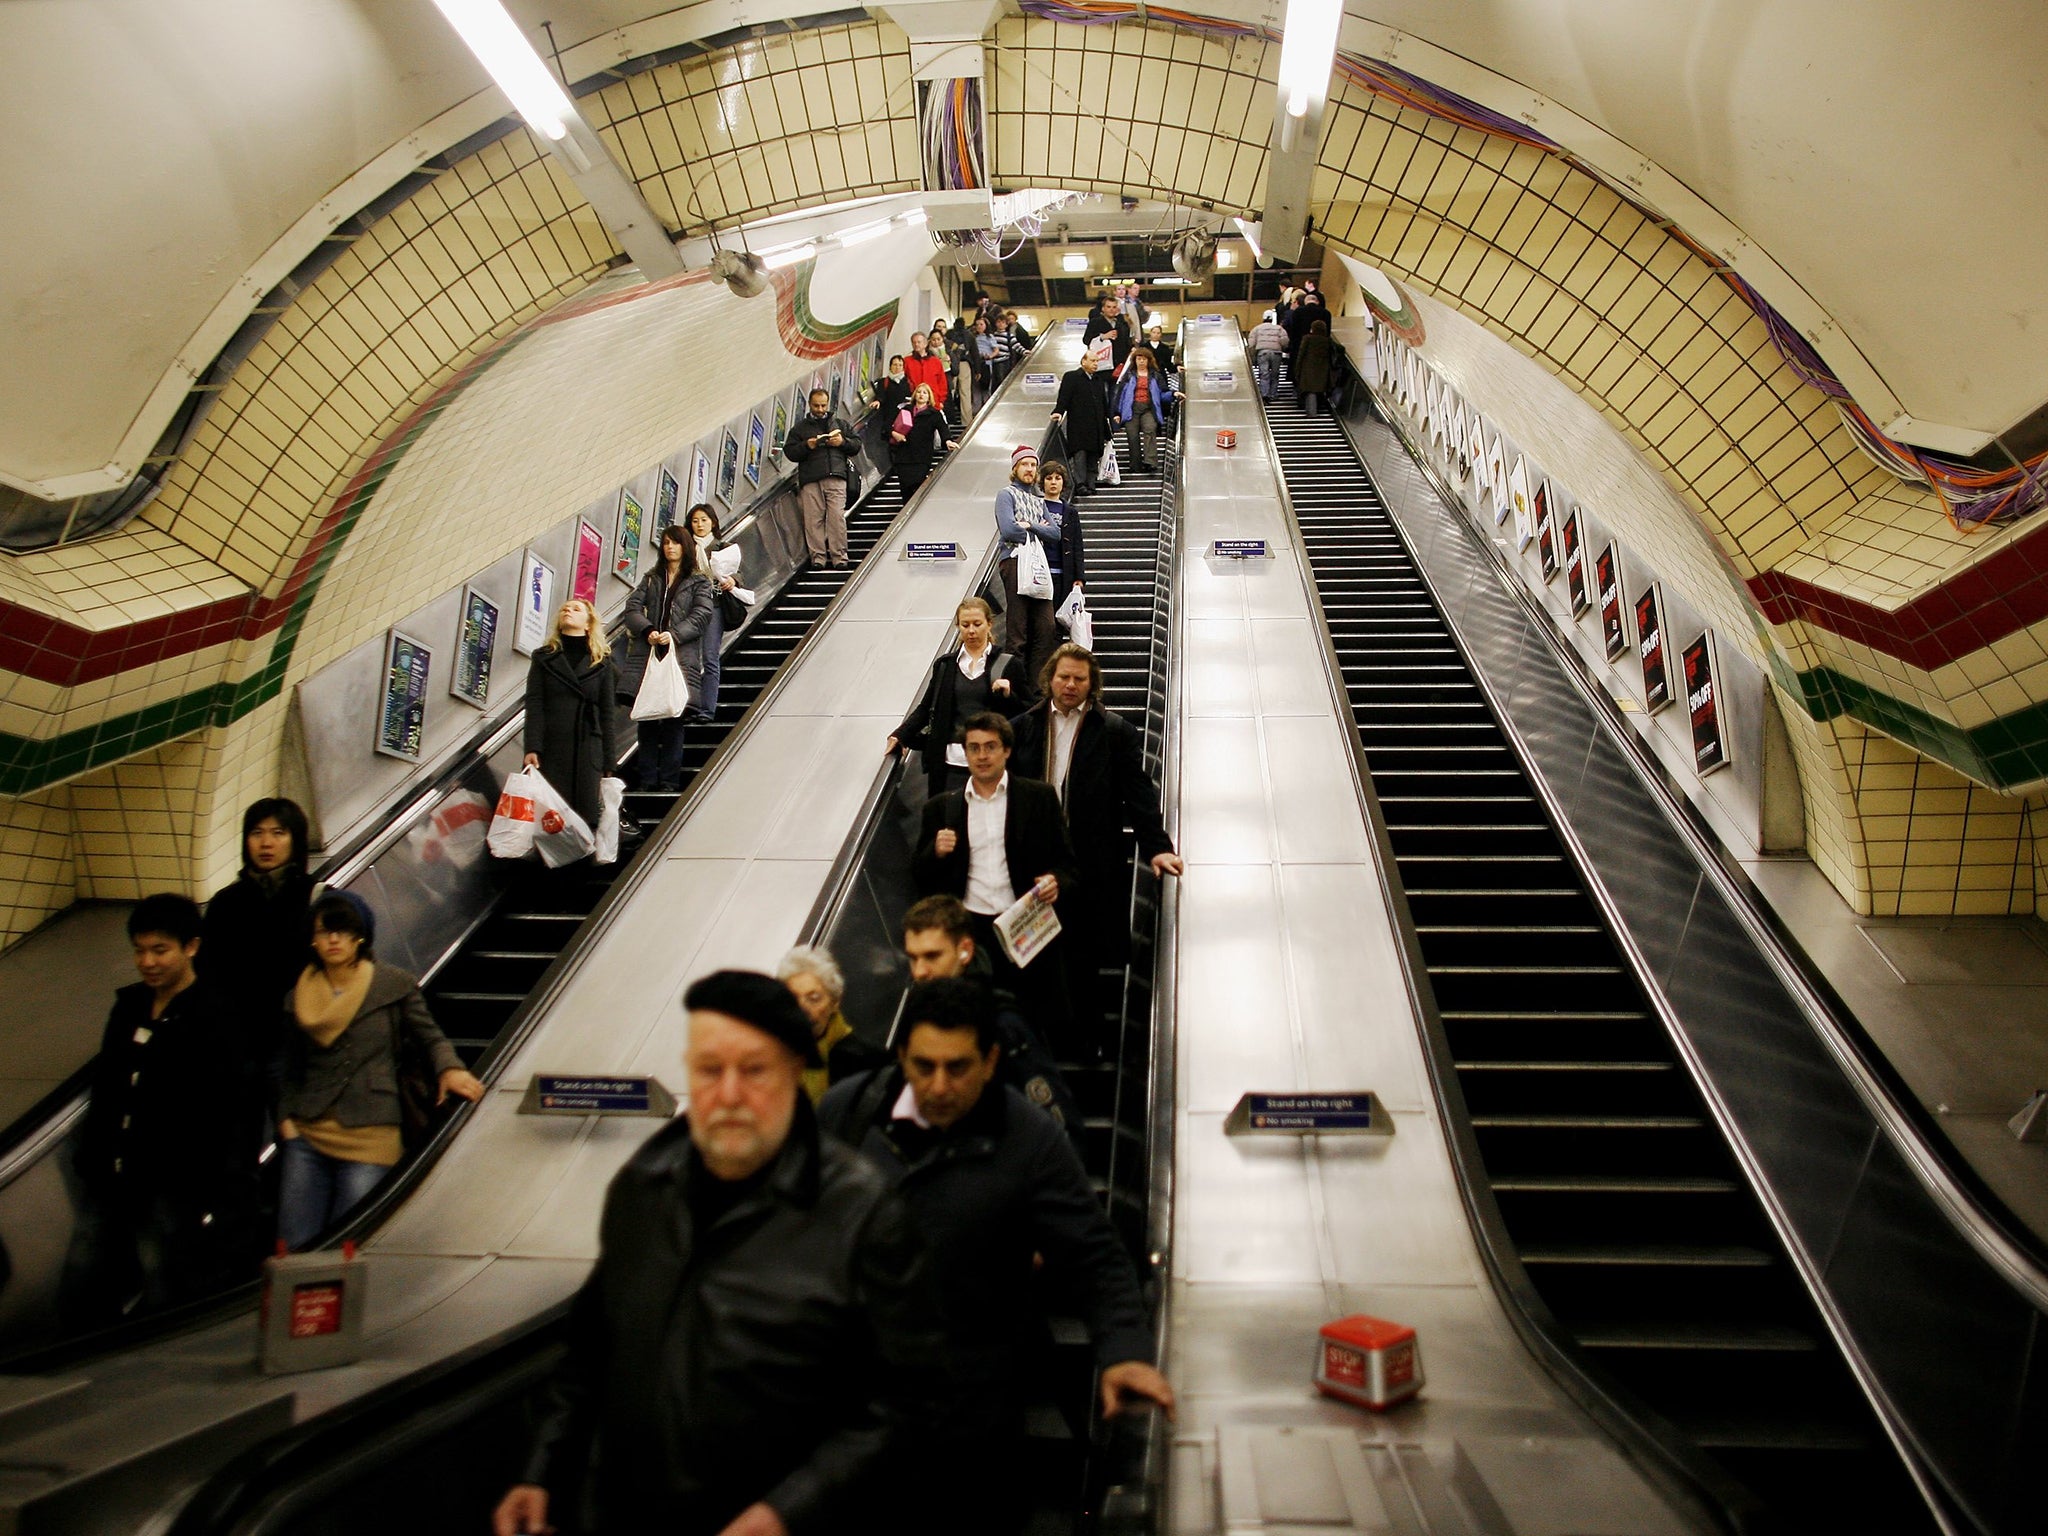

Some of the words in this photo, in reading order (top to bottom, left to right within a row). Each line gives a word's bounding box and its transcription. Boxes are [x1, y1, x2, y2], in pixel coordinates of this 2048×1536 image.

[1690, 690, 1702, 713] 50%
[1700, 682, 1711, 704] OFF
[554, 1081, 579, 1090] Stand
[594, 1082, 610, 1090] the
[611, 1082, 634, 1092] right
[1266, 1099, 1294, 1108] Stand
[1296, 1100, 1309, 1108] on
[1311, 1099, 1328, 1108] the
[1330, 1099, 1353, 1110] right
[1280, 1117, 1314, 1126] smoking
[1329, 1346, 1361, 1367] STOP
